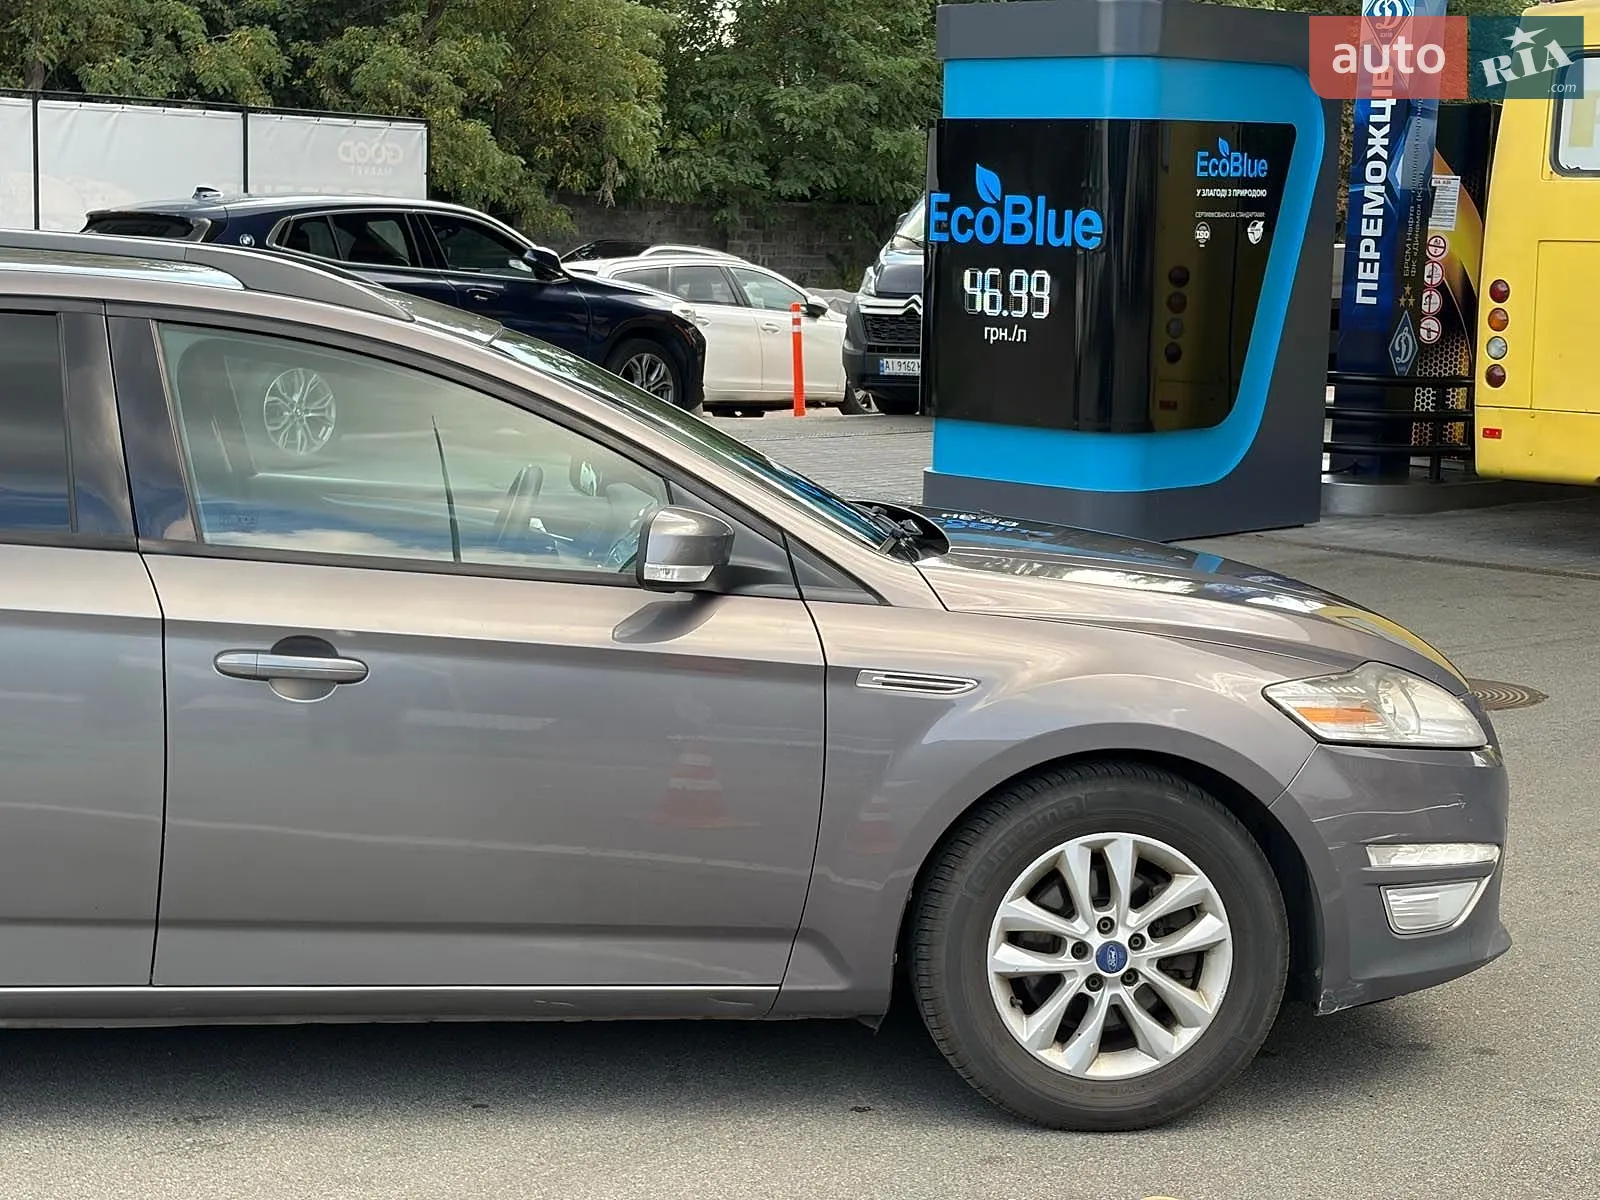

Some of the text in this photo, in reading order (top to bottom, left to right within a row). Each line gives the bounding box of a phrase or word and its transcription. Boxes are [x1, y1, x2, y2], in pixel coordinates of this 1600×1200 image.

[1196, 151, 1268, 178] EcoBlue
[1196, 188, 1201, 197] У
[1232, 188, 1267, 198] ПРИРОДОЮ
[929, 192, 1103, 250] EcoBlue
[1196, 230, 1210, 239] ISO
[963, 268, 1051, 319] 46.99
[984, 325, 1027, 344] грн./л
